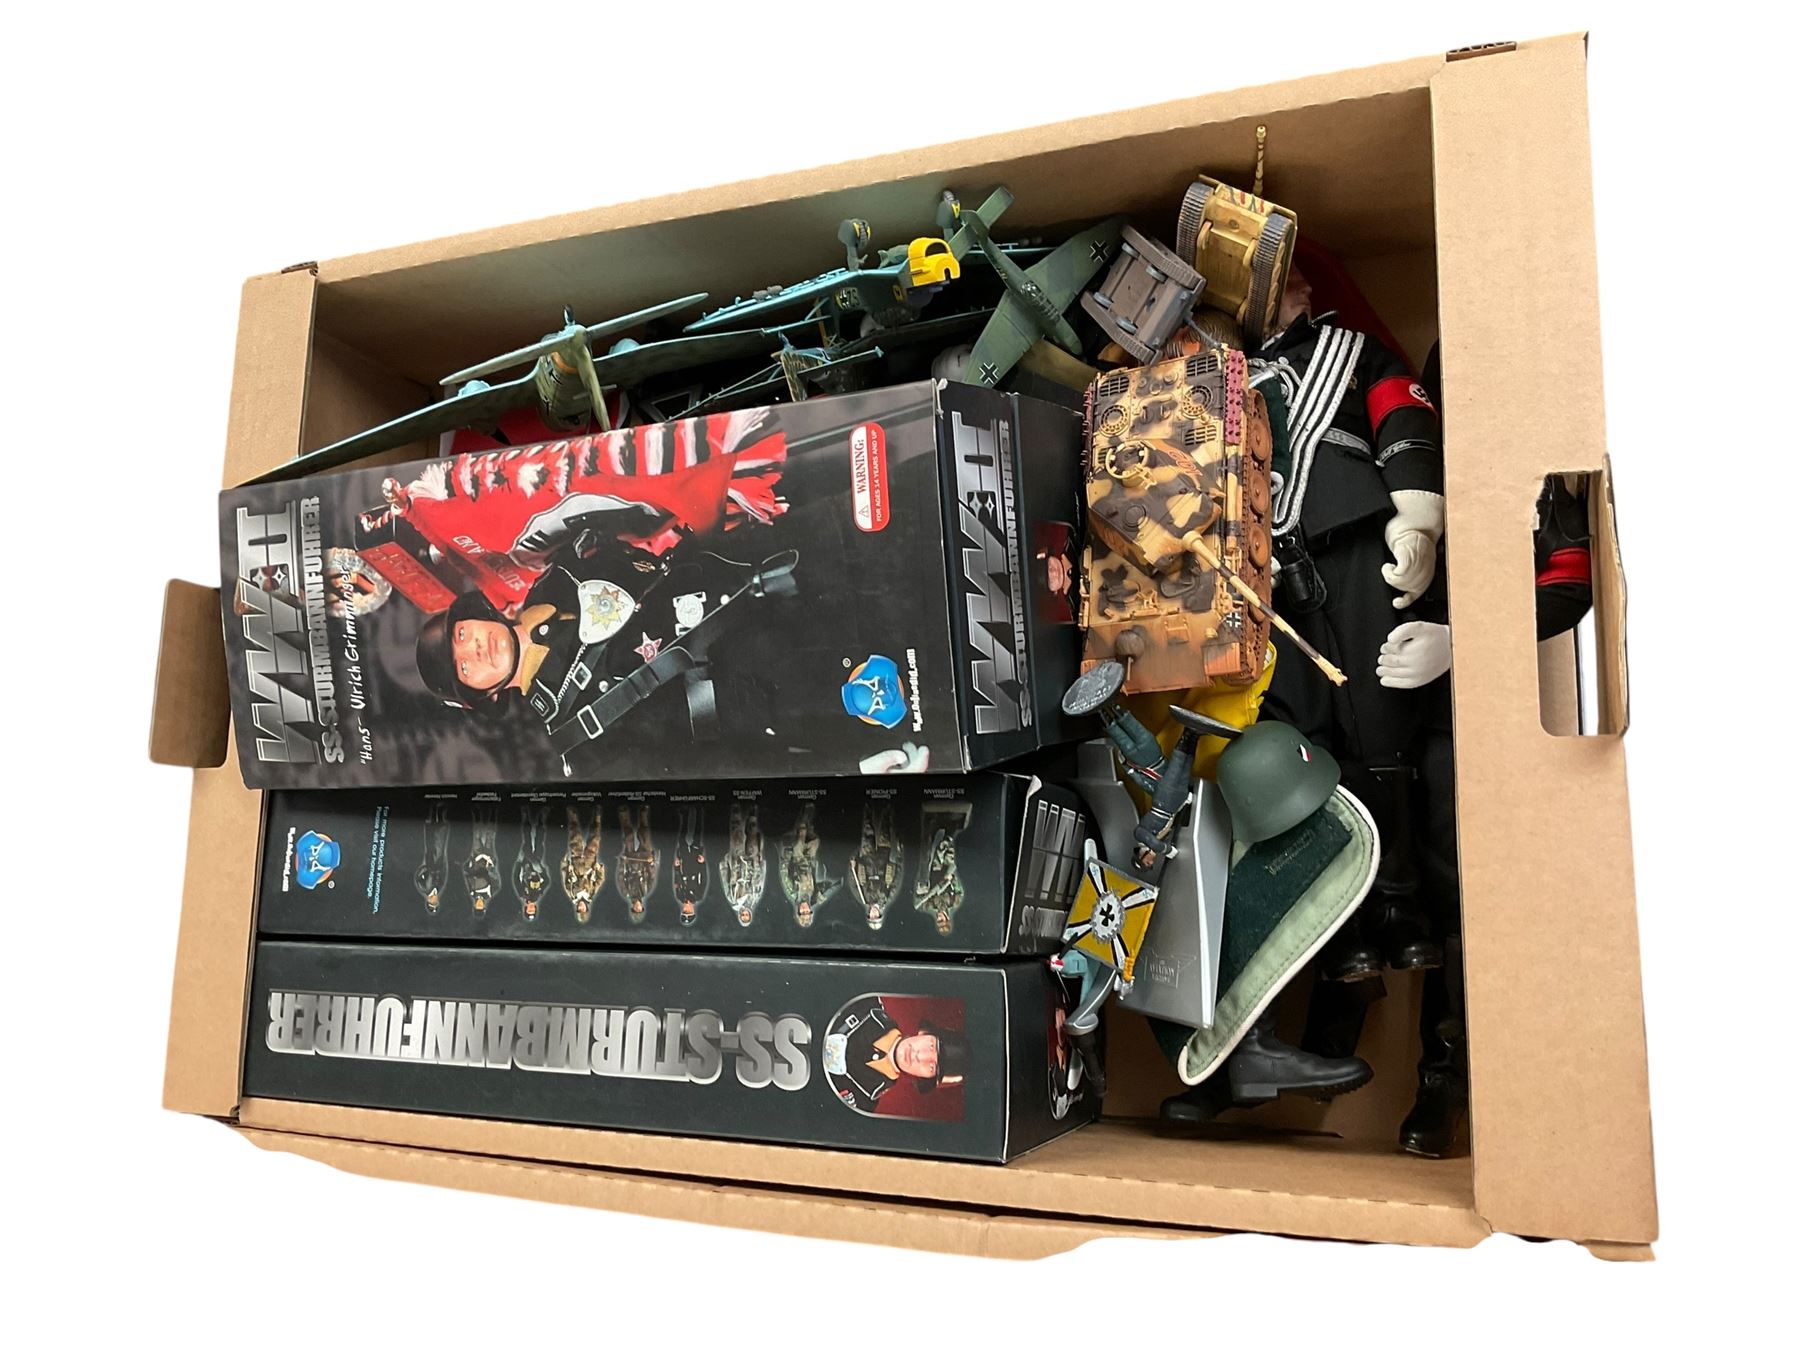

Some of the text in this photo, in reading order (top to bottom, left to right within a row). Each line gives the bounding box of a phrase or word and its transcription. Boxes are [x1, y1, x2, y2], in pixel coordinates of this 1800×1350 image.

[870, 429, 878, 439] UP
[871, 440, 879, 455] AND
[854, 439, 867, 494] WARNING:
[872, 456, 880, 479] YEARS
[873, 479, 881, 488] 14
[999, 419, 1033, 728] SS-STURMBANNFUHRER
[300, 496, 345, 763] SS-STURMBANNFUHRER
[350, 666, 368, 709] Ulrich
[373, 806, 382, 830] Please
[380, 818, 388, 838] more
[372, 830, 380, 843] visit
[370, 844, 378, 856] our
[376, 839, 386, 872] products
[266, 990, 812, 1091] SS-STURMBANNFUHRER
